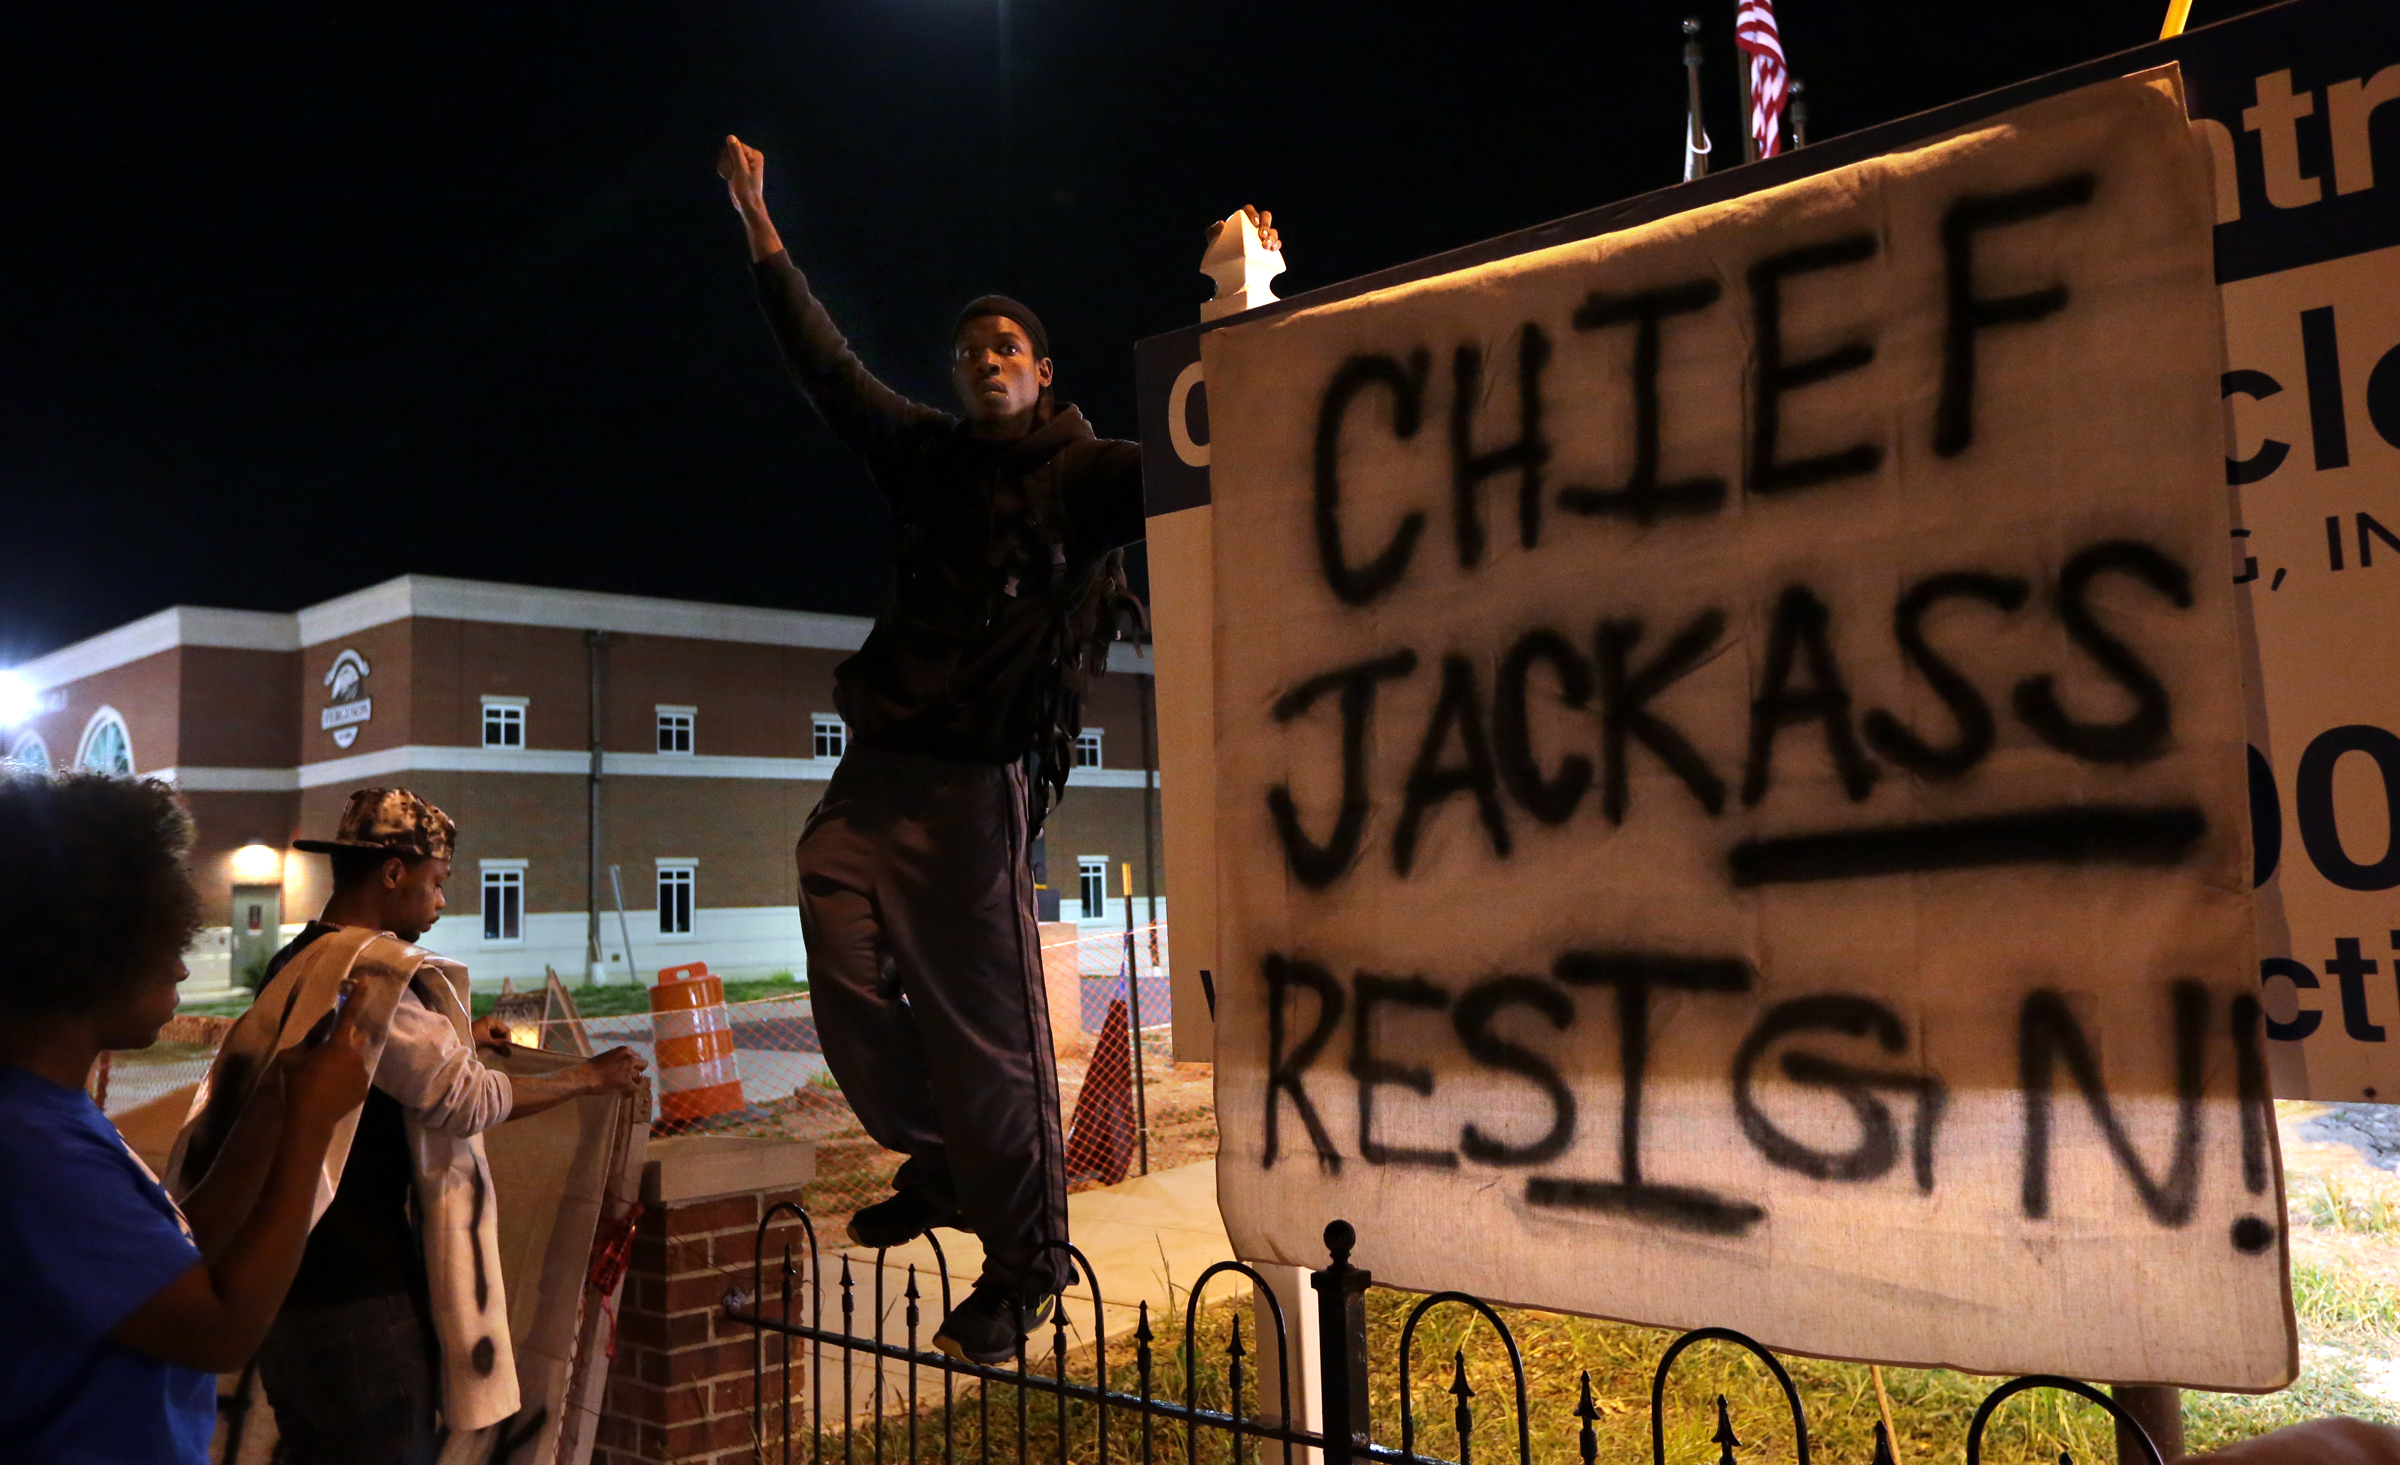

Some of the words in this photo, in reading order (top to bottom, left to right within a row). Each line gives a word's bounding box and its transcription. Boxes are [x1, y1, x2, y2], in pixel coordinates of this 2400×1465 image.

[1314, 171, 2095, 606] CHIEF
[1267, 540, 2194, 889] JACKASS
[1261, 949, 2274, 1256] RESIGN!
